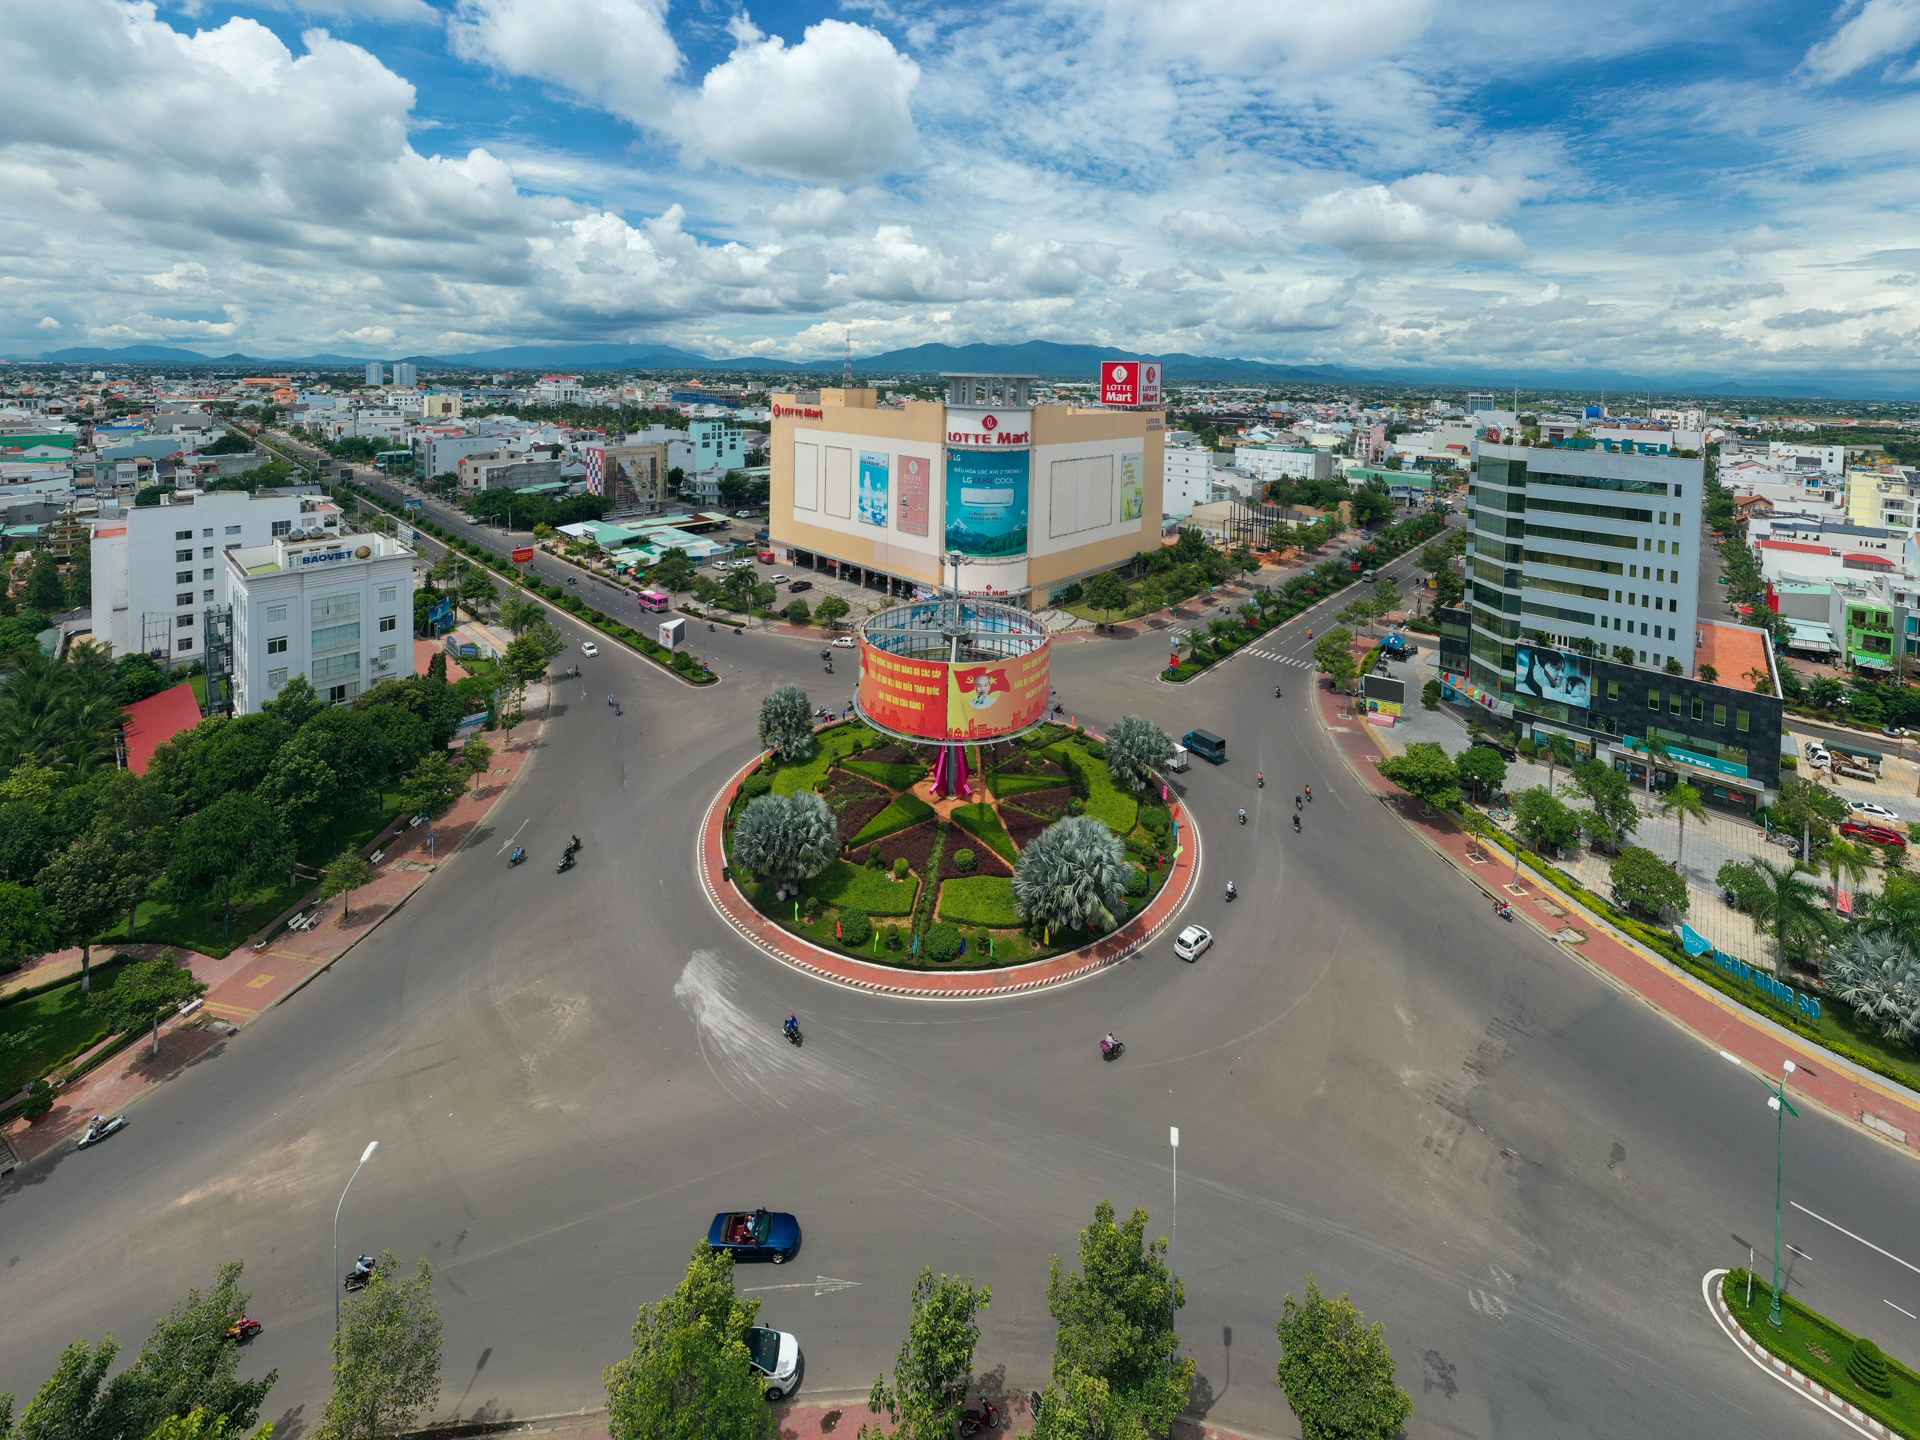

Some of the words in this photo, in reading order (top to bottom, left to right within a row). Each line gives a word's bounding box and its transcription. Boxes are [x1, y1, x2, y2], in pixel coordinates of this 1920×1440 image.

[1106, 392, 1132, 402] Mart
[1143, 393, 1157, 402] Mart
[782, 407, 803, 416] LOTTE
[804, 408, 823, 419] Mart
[948, 432, 991, 444] LOTTE
[997, 431, 1029, 444] Mart
[1549, 436, 1680, 456] VIETTEL
[303, 551, 352, 564] BAOVIET
[914, 667, 920, 677] BỘ
[921, 668, 930, 678] CÁC
[932, 668, 942, 678] CẤP
[926, 685, 940, 696] QUỐC
[1713, 947, 1751, 981] NGÂN
[1754, 969, 1795, 1006] HÀNG
[1798, 993, 1821, 1019] SỐ
